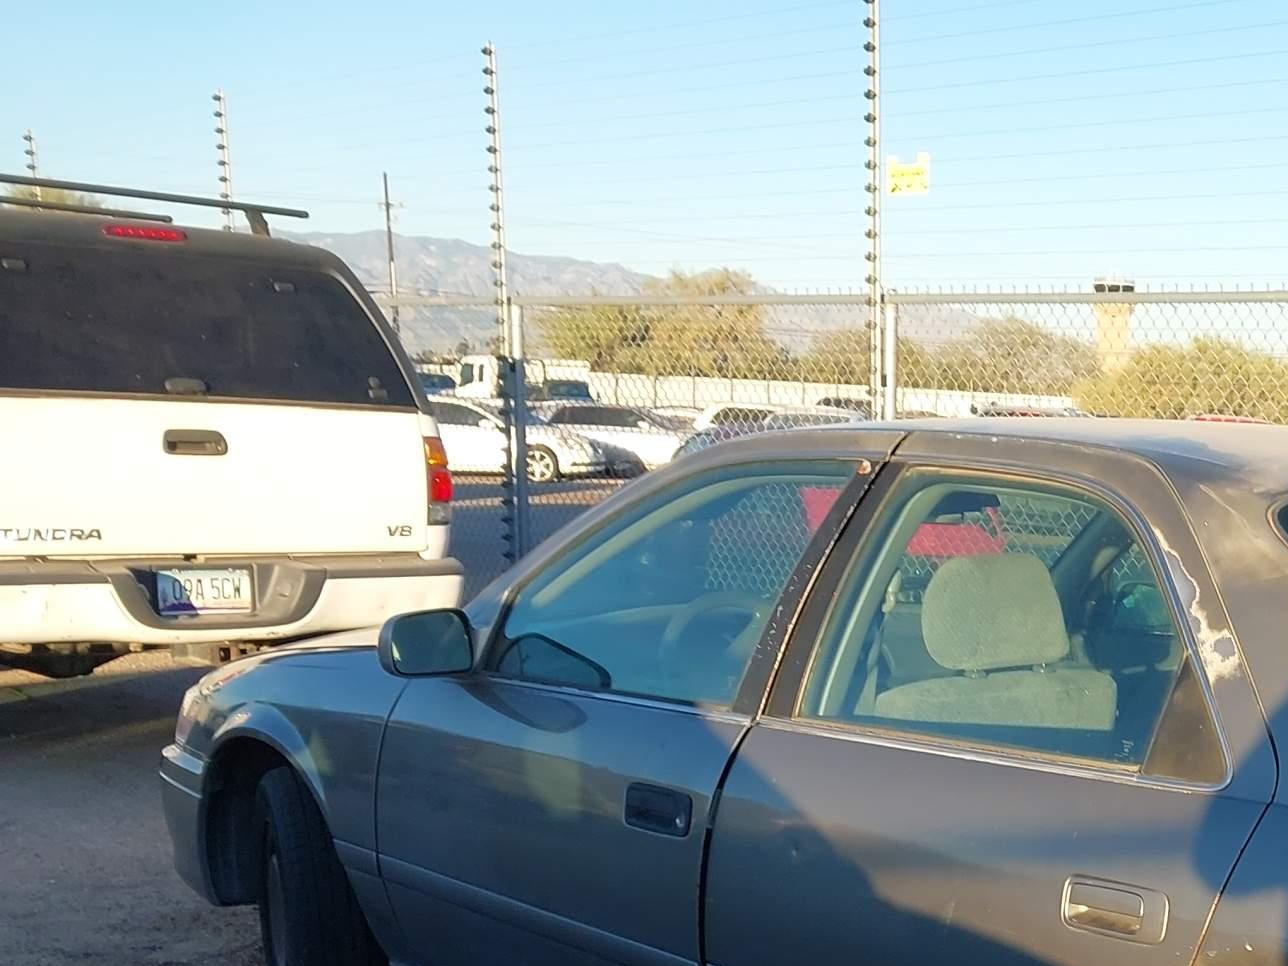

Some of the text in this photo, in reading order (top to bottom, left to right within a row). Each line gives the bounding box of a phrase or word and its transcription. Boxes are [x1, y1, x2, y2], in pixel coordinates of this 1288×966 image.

[0, 528, 102, 541] TUNDRA
[387, 525, 412, 537] V8
[210, 577, 241, 600] 5CW
